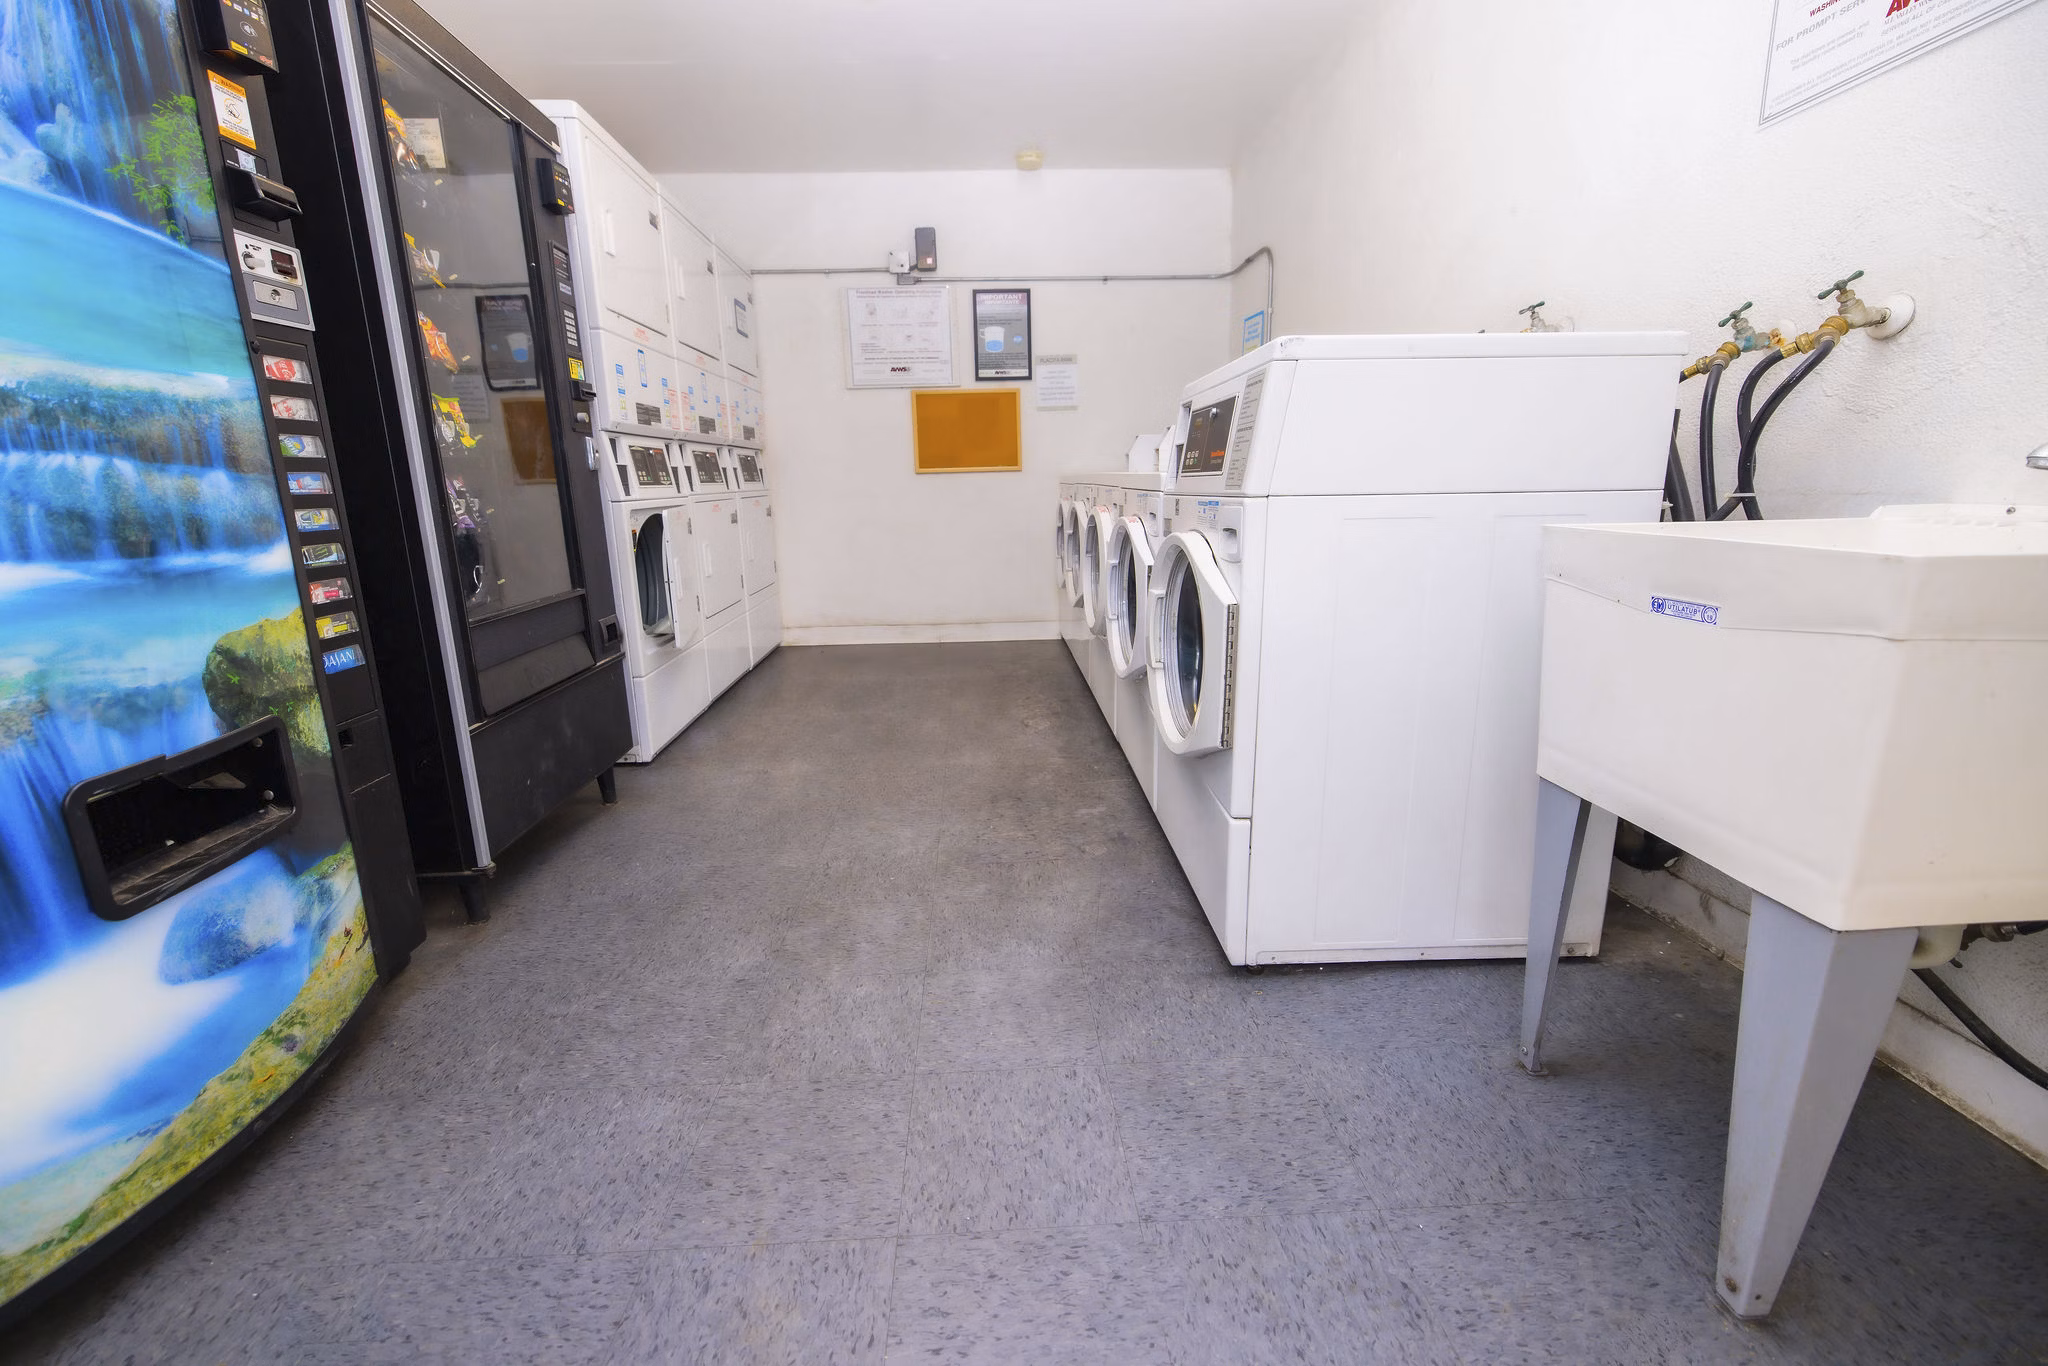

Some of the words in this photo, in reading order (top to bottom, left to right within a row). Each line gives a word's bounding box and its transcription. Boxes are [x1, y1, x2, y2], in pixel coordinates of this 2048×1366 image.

[1775, 36, 1795, 52] FOR
[1796, 12, 1838, 40] PROMPT
[1667, 603, 1698, 615] UTILATUB
